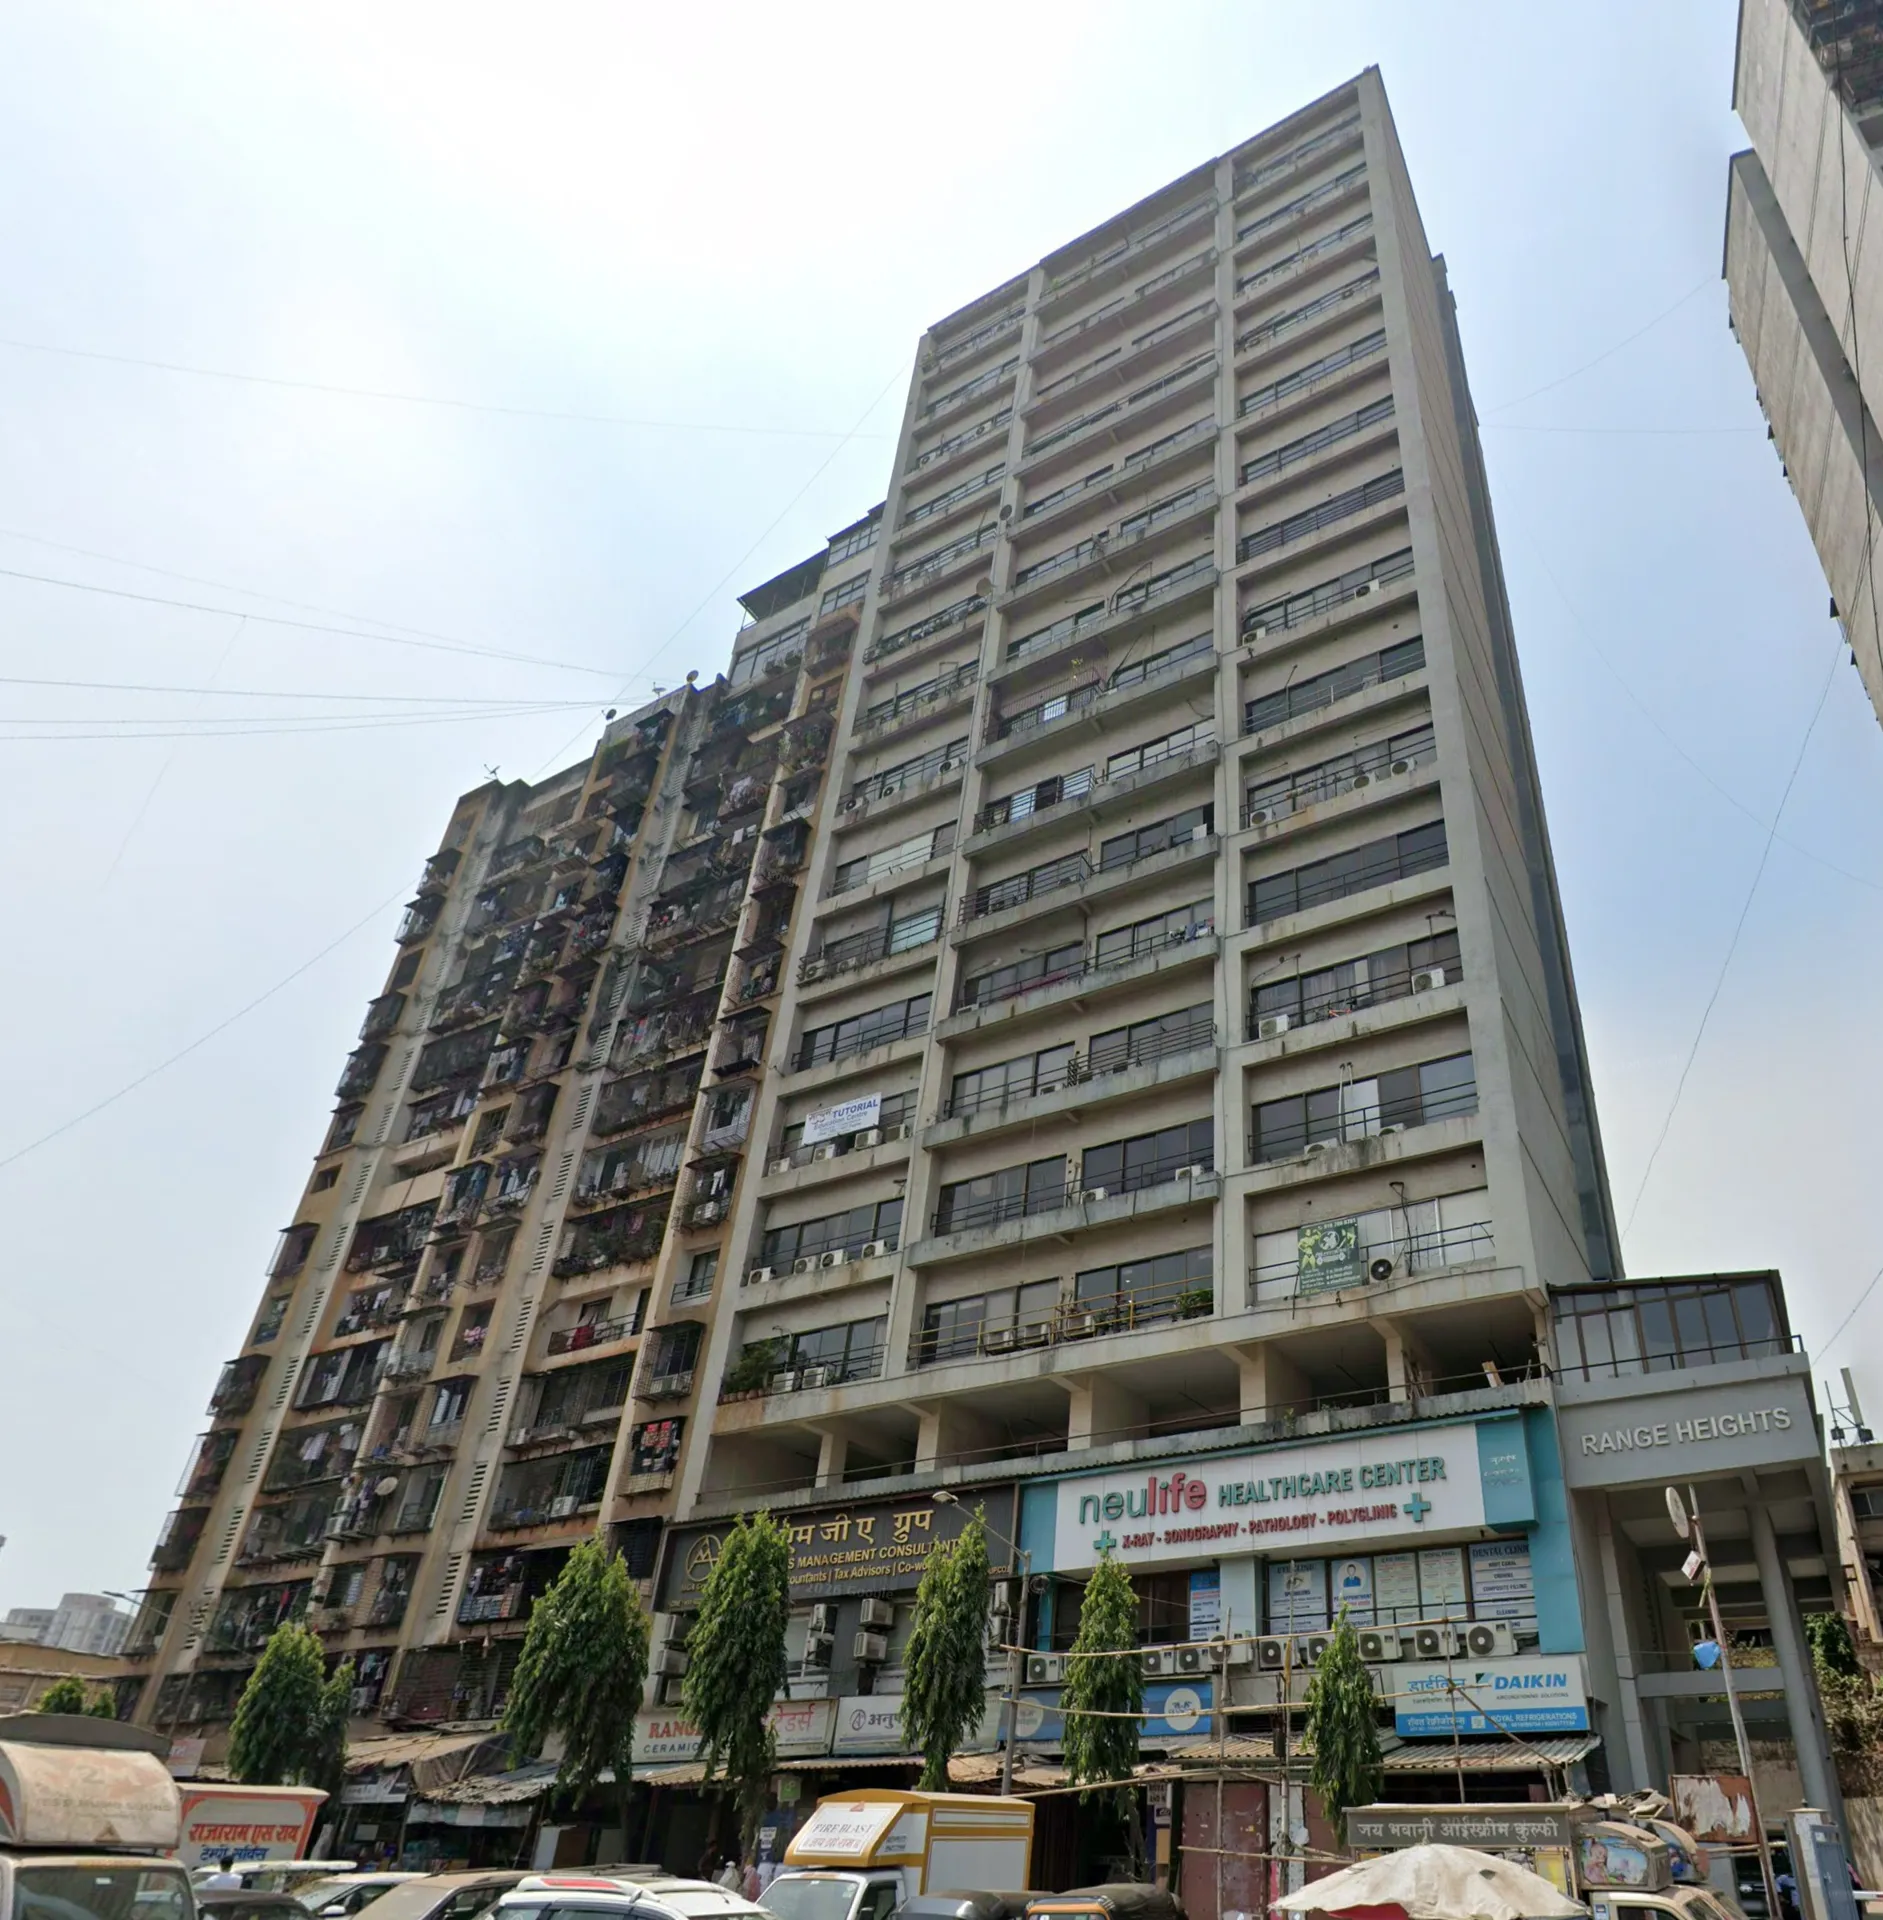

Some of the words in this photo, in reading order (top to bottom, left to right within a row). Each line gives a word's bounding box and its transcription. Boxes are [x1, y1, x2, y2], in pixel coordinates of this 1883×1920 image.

[832, 1099, 878, 1119] TUTORIAL
[846, 1111, 868, 1122] Centre
[1581, 1424, 1670, 1456] RANGE
[1675, 1407, 1792, 1443] HEIGHTS
[1079, 1472, 1207, 1524] neulife
[1218, 1467, 1354, 1507] HEALTHCARE
[1359, 1456, 1447, 1489] CENTER
[893, 1509, 934, 1543] ग्रुप
[1122, 1532, 1155, 1549] X-RAY
[1164, 1522, 1239, 1545] SONOGRAPHY
[1249, 1512, 1317, 1535] PATHOLOGY
[1327, 1503, 1397, 1526] POLYCLINIC
[797, 1548, 877, 1568] MANAGEMENT
[834, 1566, 849, 1580] Tax
[849, 1563, 891, 1579] Advisors
[1494, 1673, 1567, 1690] DAIKIN
[188, 1824, 252, 1842] राजाराम
[812, 1823, 840, 1833] FIRE
[1357, 1823, 1384, 1837] जय
[1388, 1817, 1435, 1838] भवानी
[1512, 1816, 1560, 1843] कुल्फी
